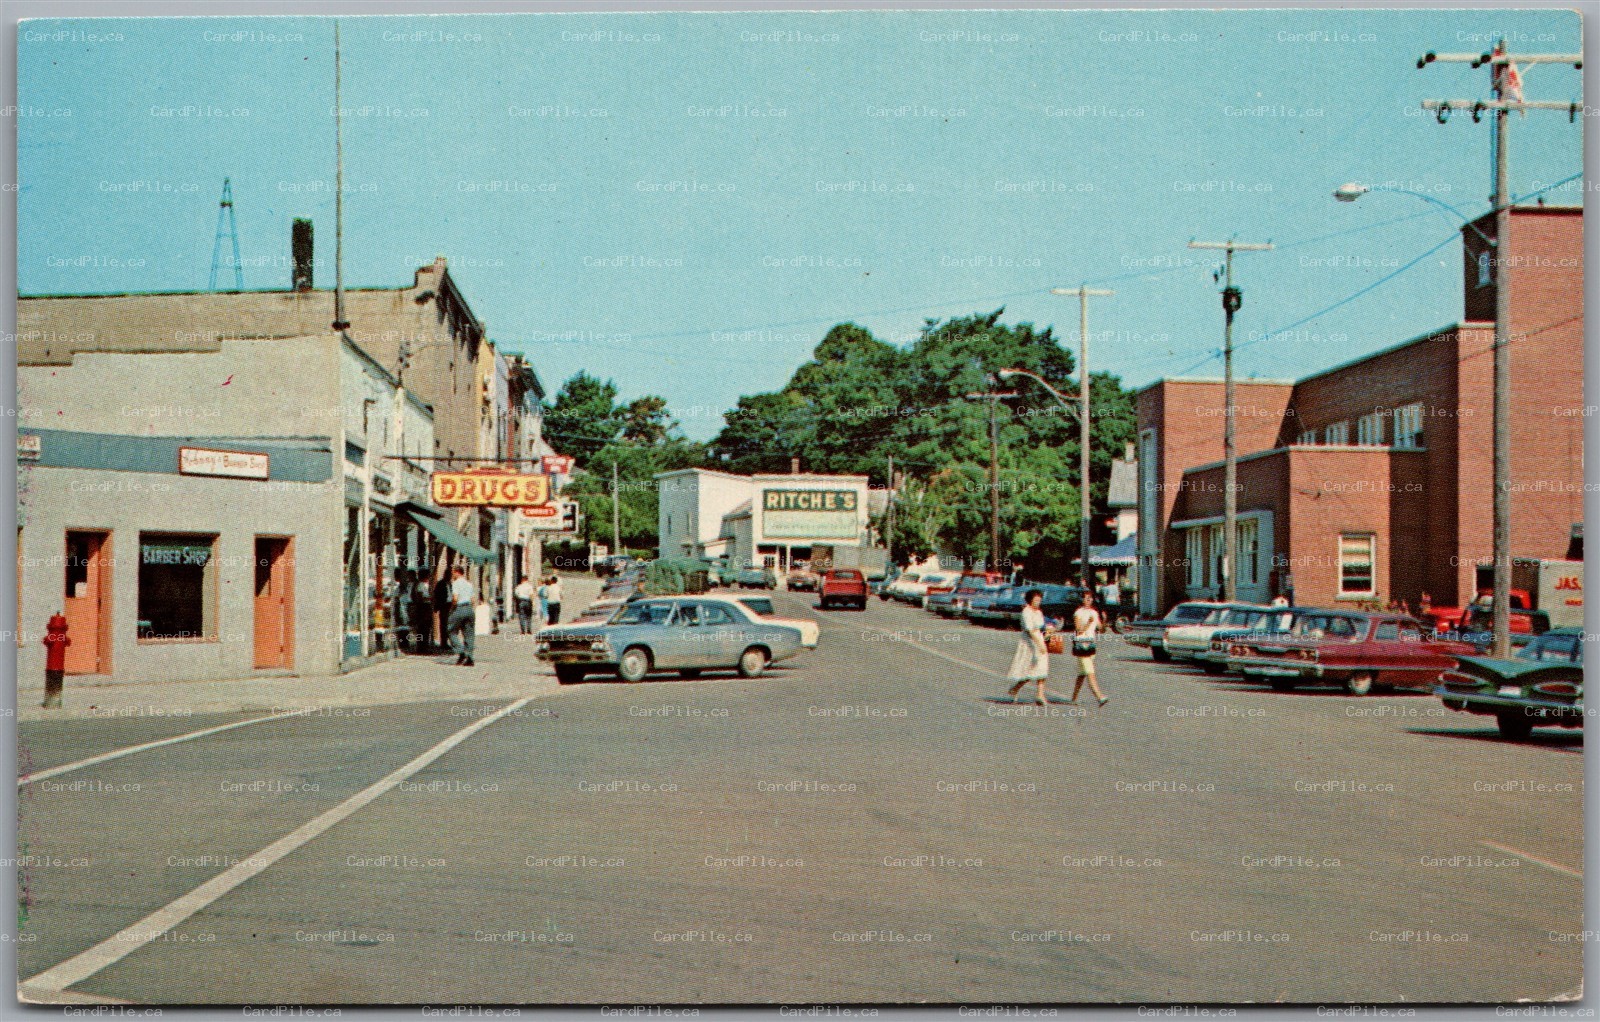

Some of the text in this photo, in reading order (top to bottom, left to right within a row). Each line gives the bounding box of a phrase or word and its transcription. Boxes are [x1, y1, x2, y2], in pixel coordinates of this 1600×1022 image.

[440, 478, 541, 501] DRUGS
[766, 491, 855, 509] RITCHE'S
[143, 545, 181, 564] BARBER
[1554, 577, 1582, 590] JAS.
